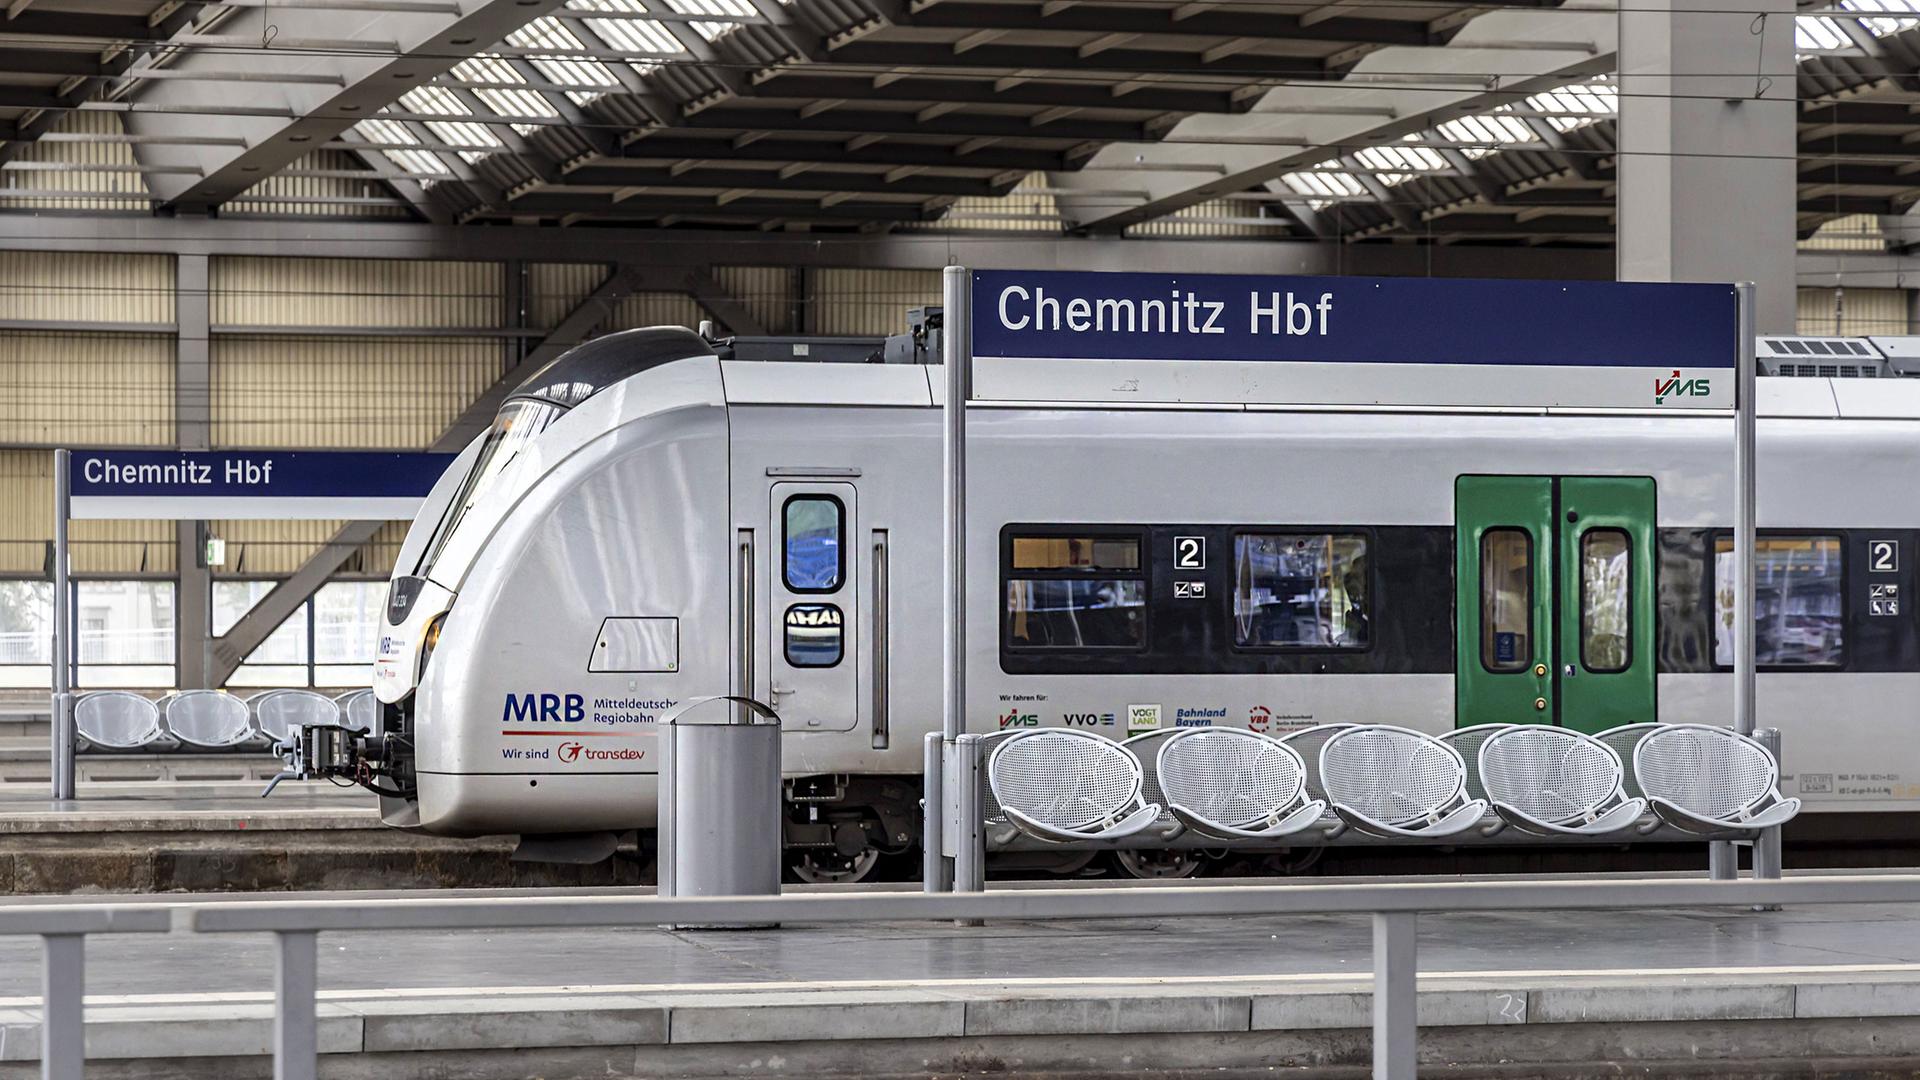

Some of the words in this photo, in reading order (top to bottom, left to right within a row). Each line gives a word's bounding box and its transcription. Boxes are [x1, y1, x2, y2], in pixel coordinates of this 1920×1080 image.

[998, 285, 1225, 334] Chemnitz
[1250, 291, 1333, 336] Hbf
[1655, 370, 1710, 397] VMS
[84, 458, 212, 484] Chemnitz
[225, 459, 272, 484] Hbf
[1180, 539, 1199, 567] 2
[1874, 543, 1893, 570] 2
[502, 693, 586, 723] MRB
[1132, 708, 1157, 717] VOGT
[1177, 708, 1226, 718] Bahnland
[593, 712, 654, 725] Regiobahn
[1000, 709, 1038, 726] VMS
[1064, 713, 1098, 726] VVO
[1133, 717, 1157, 725] LAND
[1175, 718, 1212, 728] Bayern
[1250, 715, 1269, 724] VBB
[502, 748, 523, 759] Wir
[525, 748, 550, 759] sind
[585, 748, 645, 760] transdev
